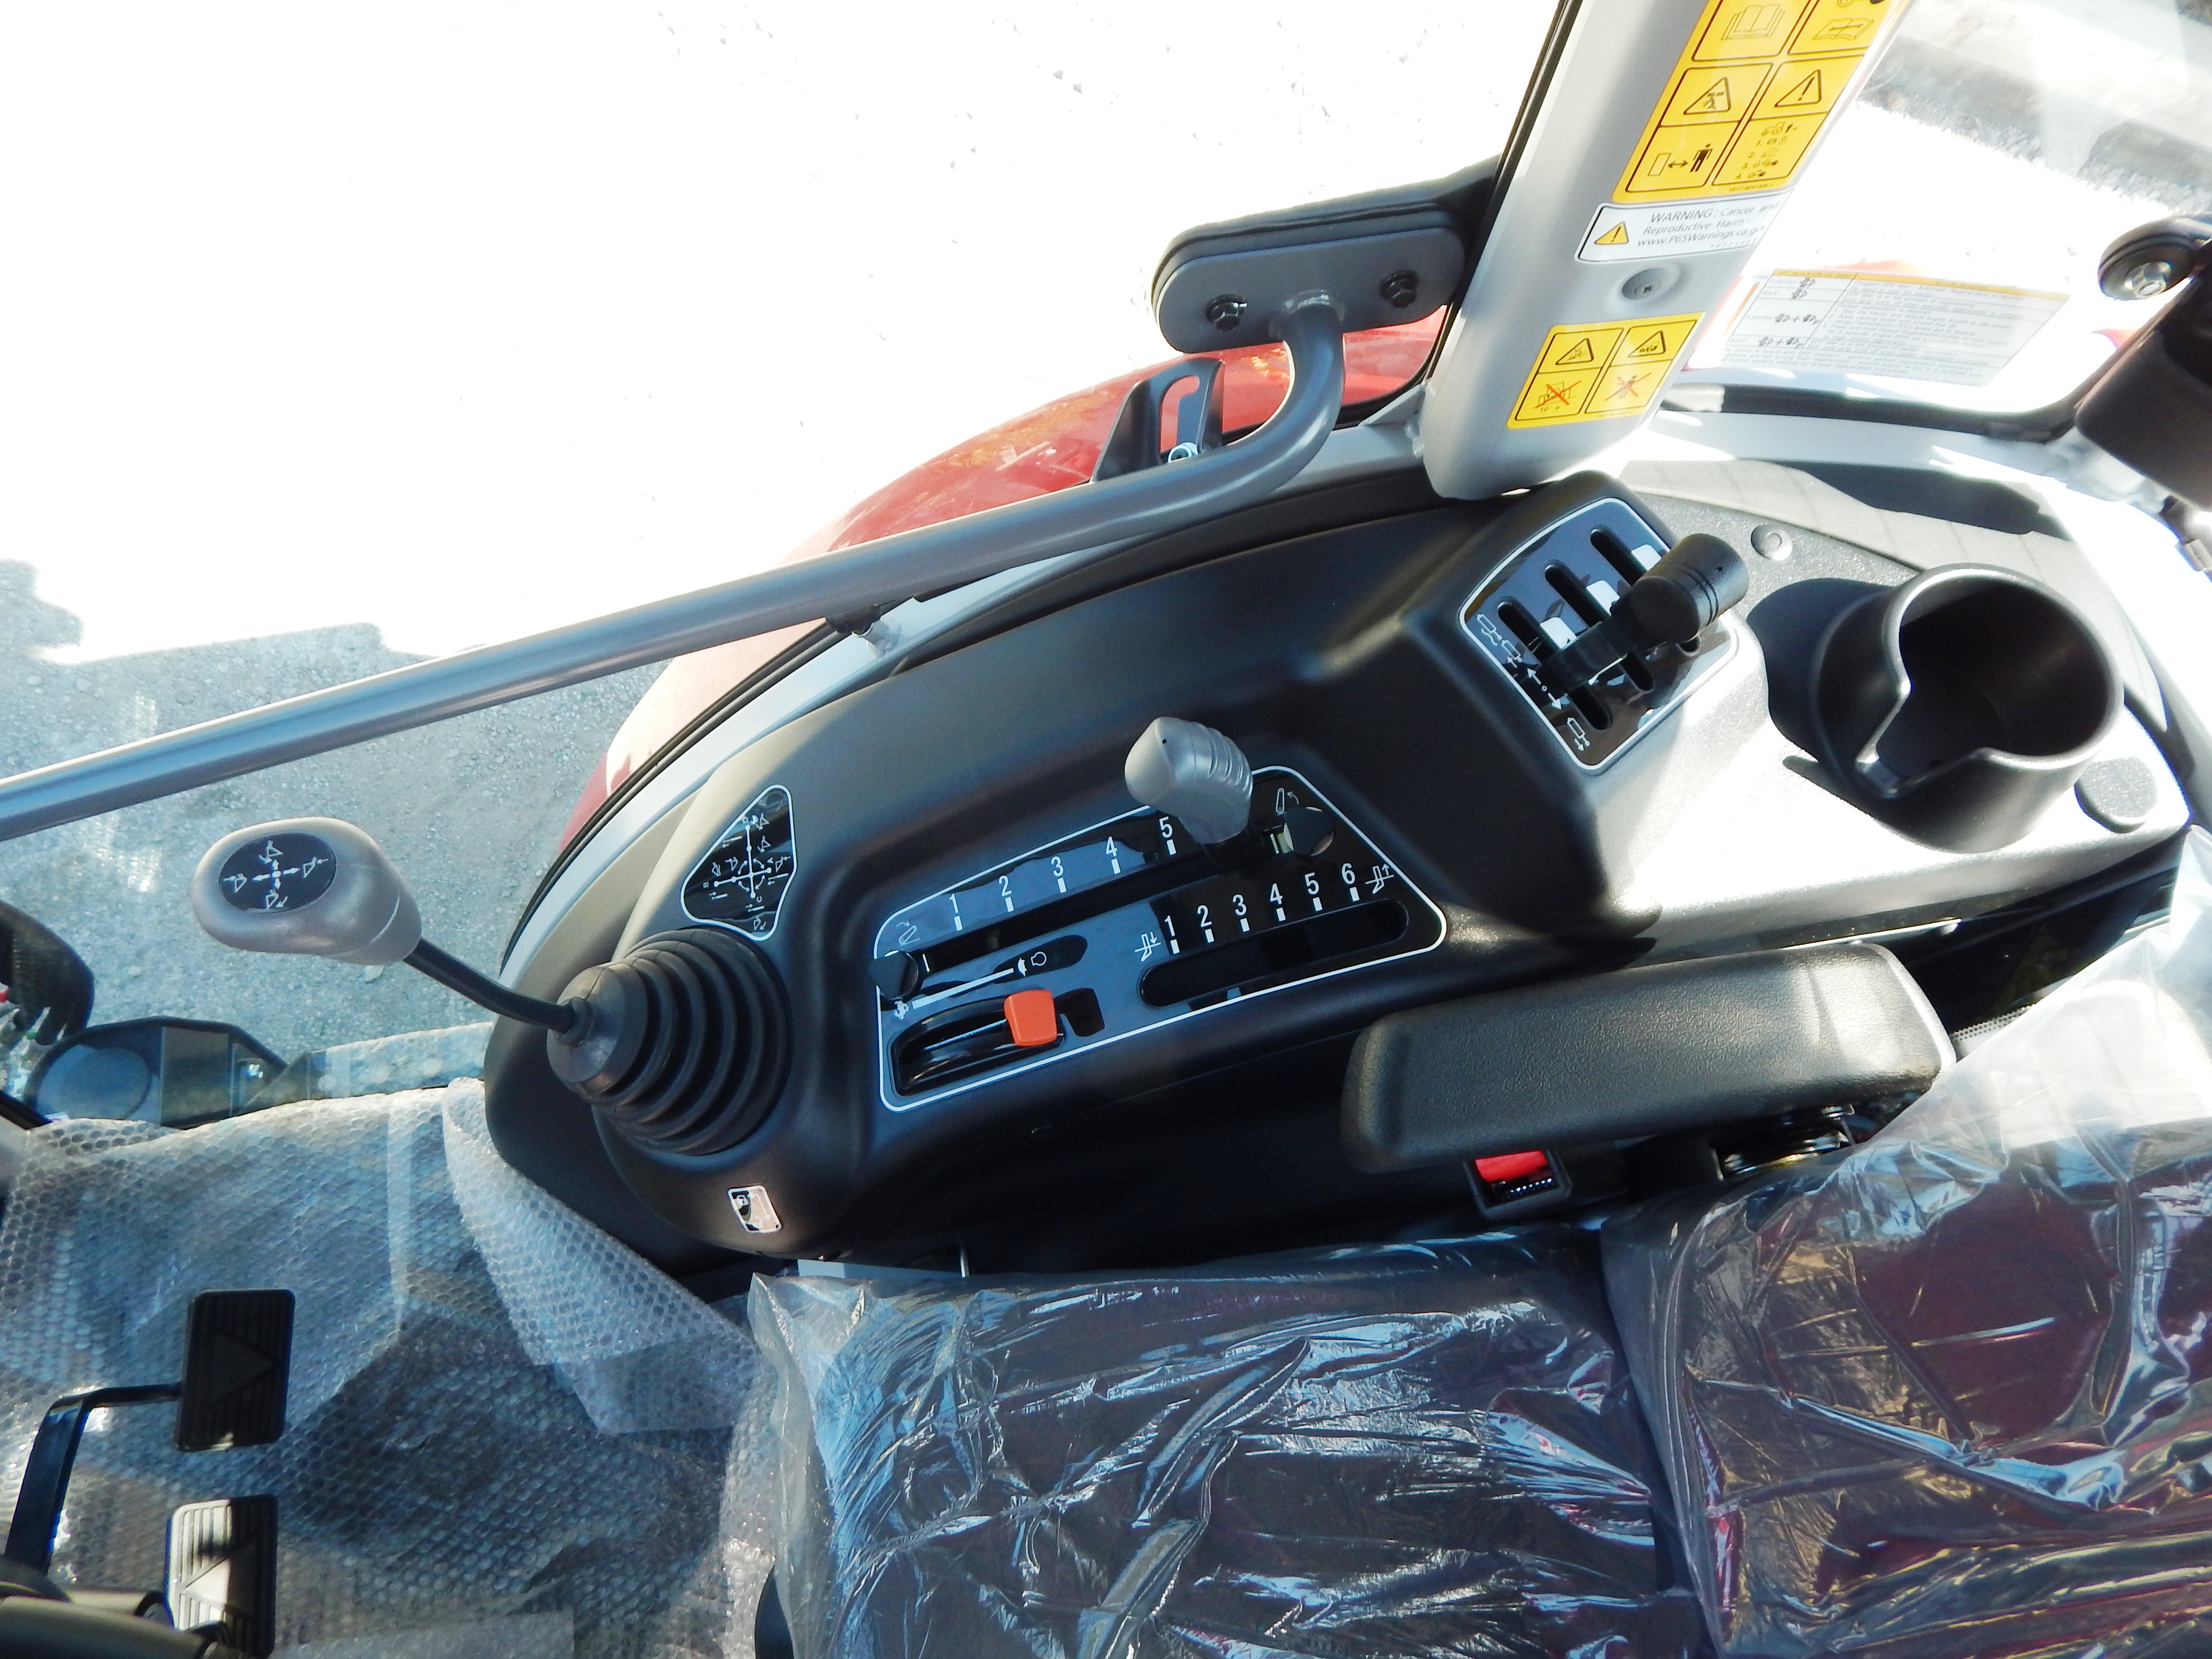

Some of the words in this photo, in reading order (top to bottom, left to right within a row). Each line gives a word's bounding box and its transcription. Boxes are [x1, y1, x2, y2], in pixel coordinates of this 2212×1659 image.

[1643, 223, 1711, 236] Reproductive
[1716, 219, 1744, 228] Harm
[1720, 206, 1755, 217] Cancer
[950, 893, 959, 914] 1
[998, 875, 1012, 896] 2
[1051, 856, 1063, 877] 3
[1106, 836, 1118, 856] 4
[1159, 816, 1173, 838] 5
[1165, 915, 1176, 936] 1
[1197, 905, 1212, 927] 2
[1233, 894, 1247, 915] 3
[1270, 883, 1283, 904] 4
[1305, 872, 1319, 894] 5
[1342, 863, 1355, 884] 6
